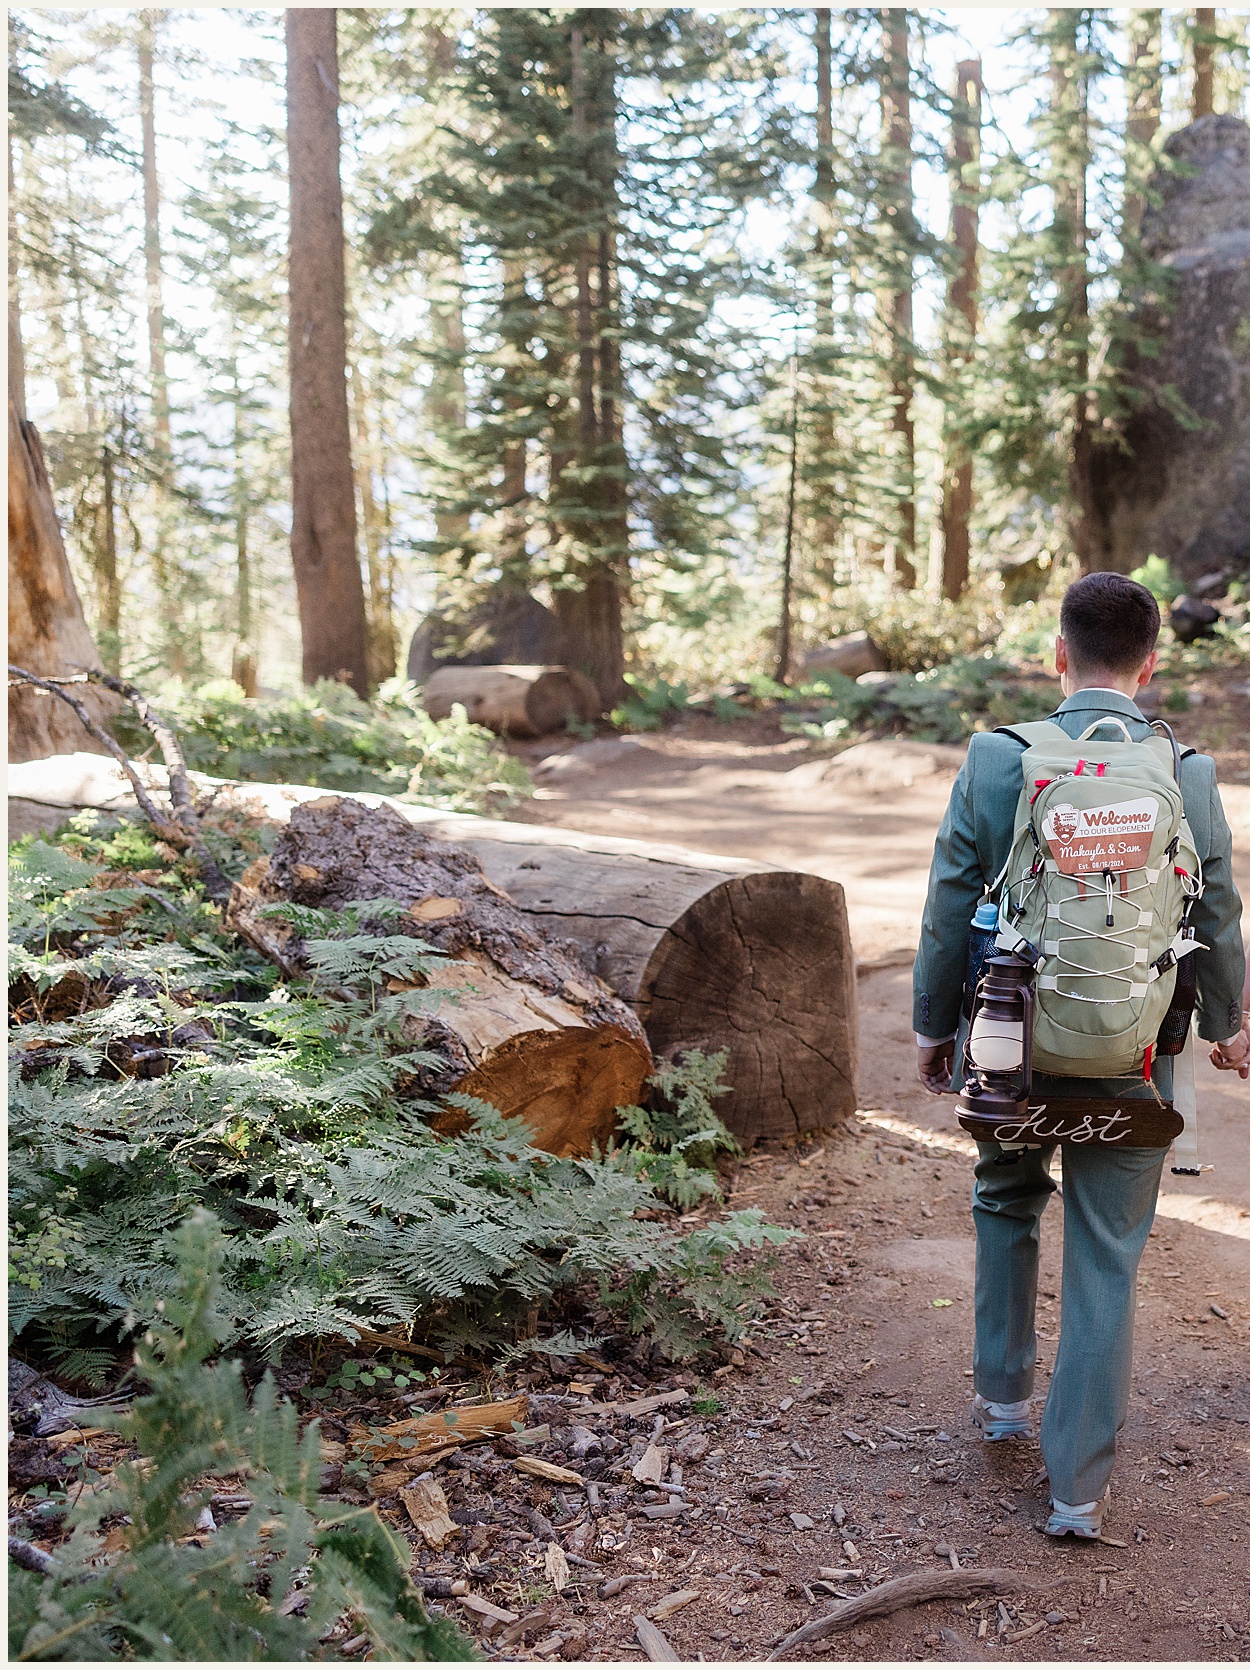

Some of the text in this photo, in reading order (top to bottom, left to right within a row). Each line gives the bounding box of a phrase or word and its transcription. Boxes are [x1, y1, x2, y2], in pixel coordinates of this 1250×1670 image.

[1083, 810, 1152, 827] Welcome
[1108, 824, 1151, 834] ELOPEMENT
[1060, 842, 1142, 861] Makayla & Sam
[993, 1104, 1133, 1143] Just
